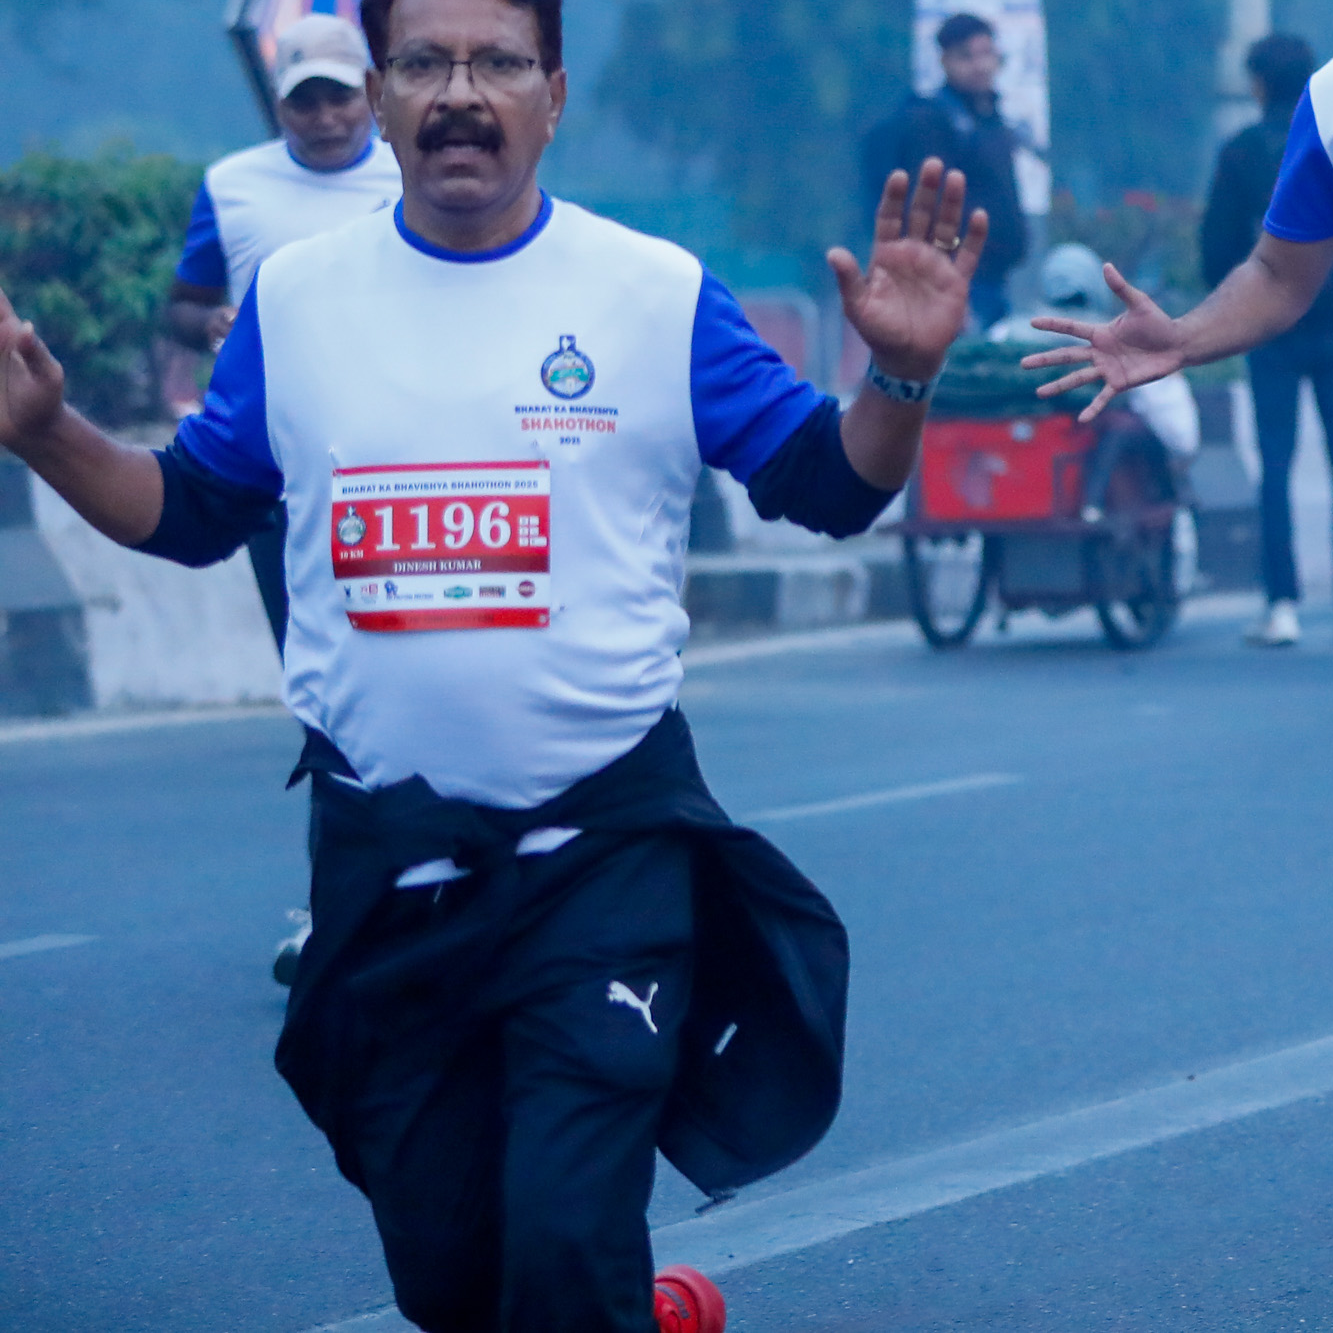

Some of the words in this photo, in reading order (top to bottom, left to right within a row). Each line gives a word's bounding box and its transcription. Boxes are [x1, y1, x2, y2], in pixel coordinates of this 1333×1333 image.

[521, 418, 616, 433] SHAHOTHON
[342, 484, 377, 495] BHARAT
[379, 483, 392, 492] KA
[394, 481, 448, 492] BHAVISHYA
[451, 480, 512, 491] SHAHOTHON
[514, 479, 539, 489] 2025
[374, 500, 512, 551] 1196
[350, 549, 364, 559] KM
[394, 560, 437, 573] DINESH
[440, 559, 482, 571] KUMAR
